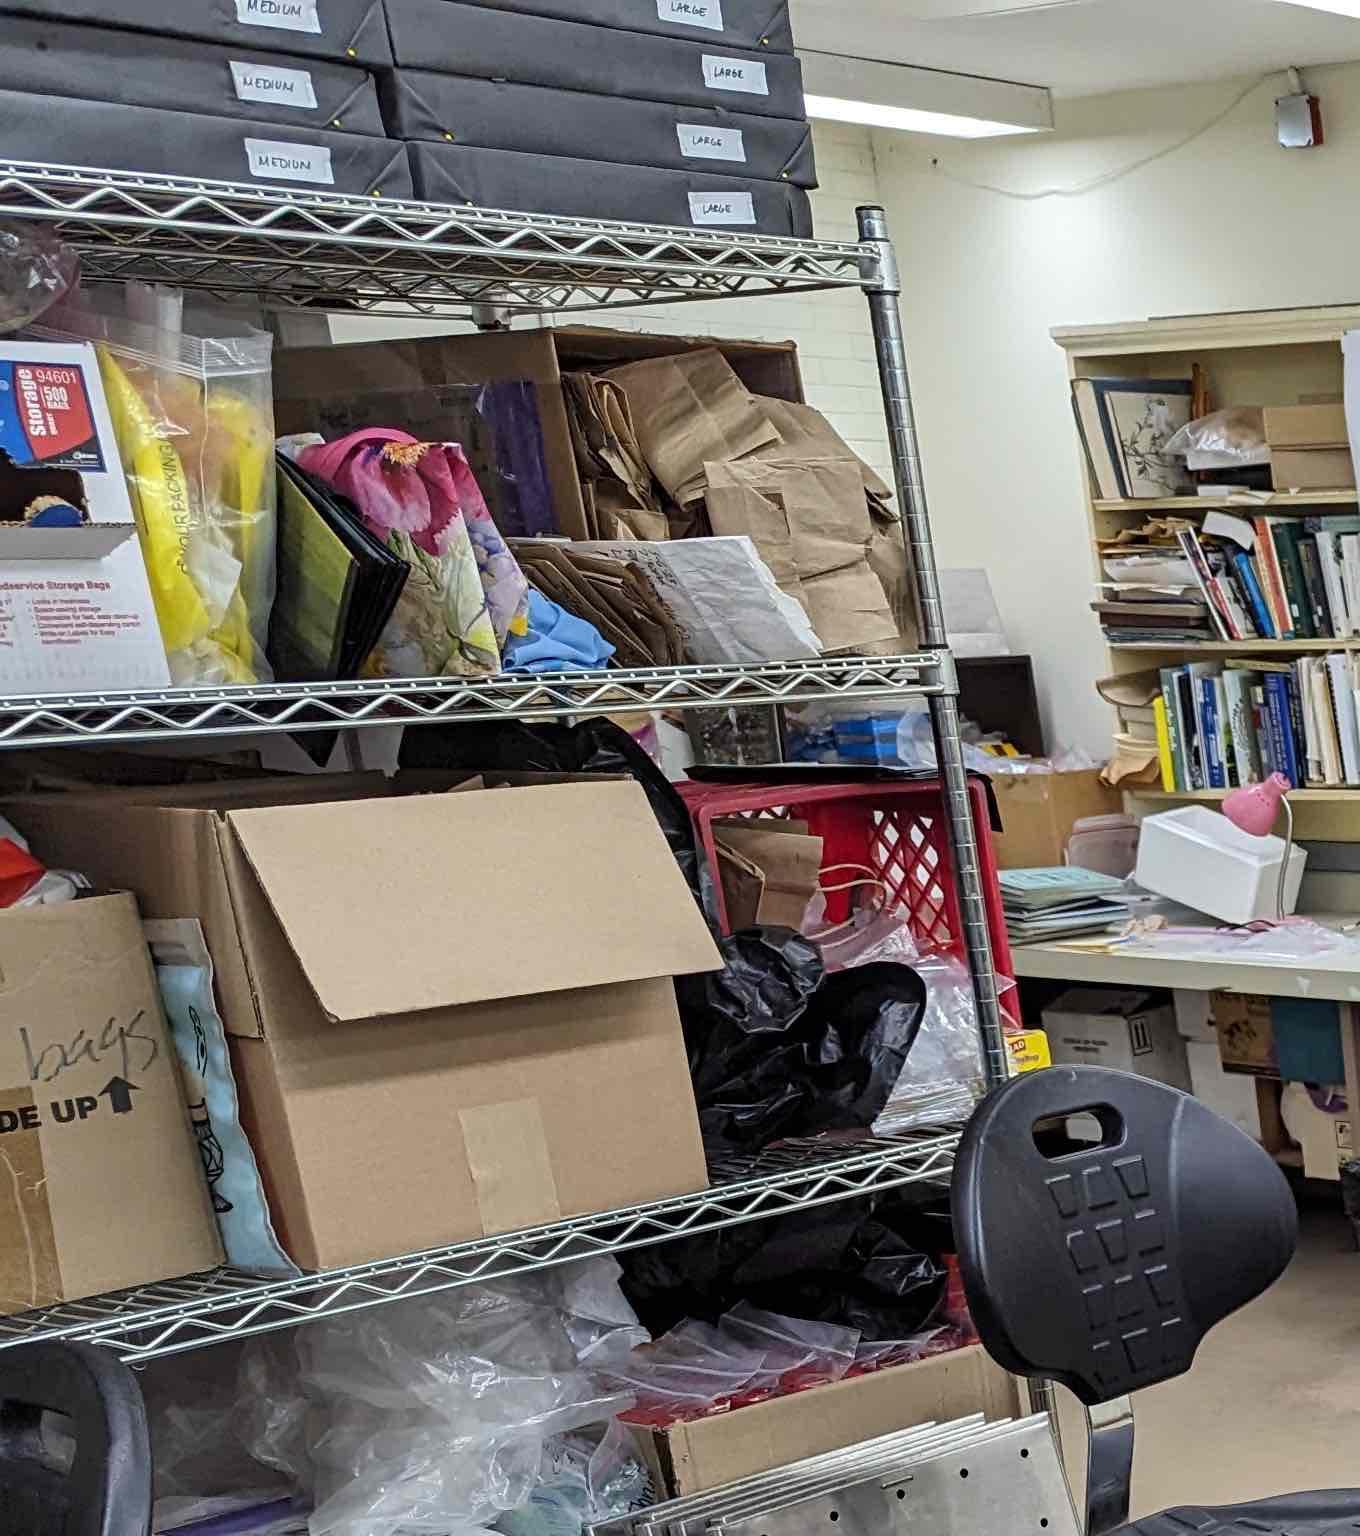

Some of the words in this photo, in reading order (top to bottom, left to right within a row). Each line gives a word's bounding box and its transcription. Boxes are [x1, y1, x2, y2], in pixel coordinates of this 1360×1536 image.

[247, 0, 302, 17] MEDIUM
[671, 1, 708, 17] LARGE
[713, 66, 744, 80] LARGE
[242, 77, 294, 93] MEDIUM
[692, 135, 723, 148] LARGE
[258, 155, 311, 171] MEDIUM
[702, 203, 733, 216] LARGE
[36, 369, 77, 385] 94601
[18, 368, 47, 437] Storage
[44, 385, 69, 404] 500
[160, 440, 187, 513] PACKING
[46, 580, 84, 592] Storage
[86, 580, 111, 592] Bags
[20, 1010, 158, 1082] bags
[50, 1095, 98, 1123] UP
